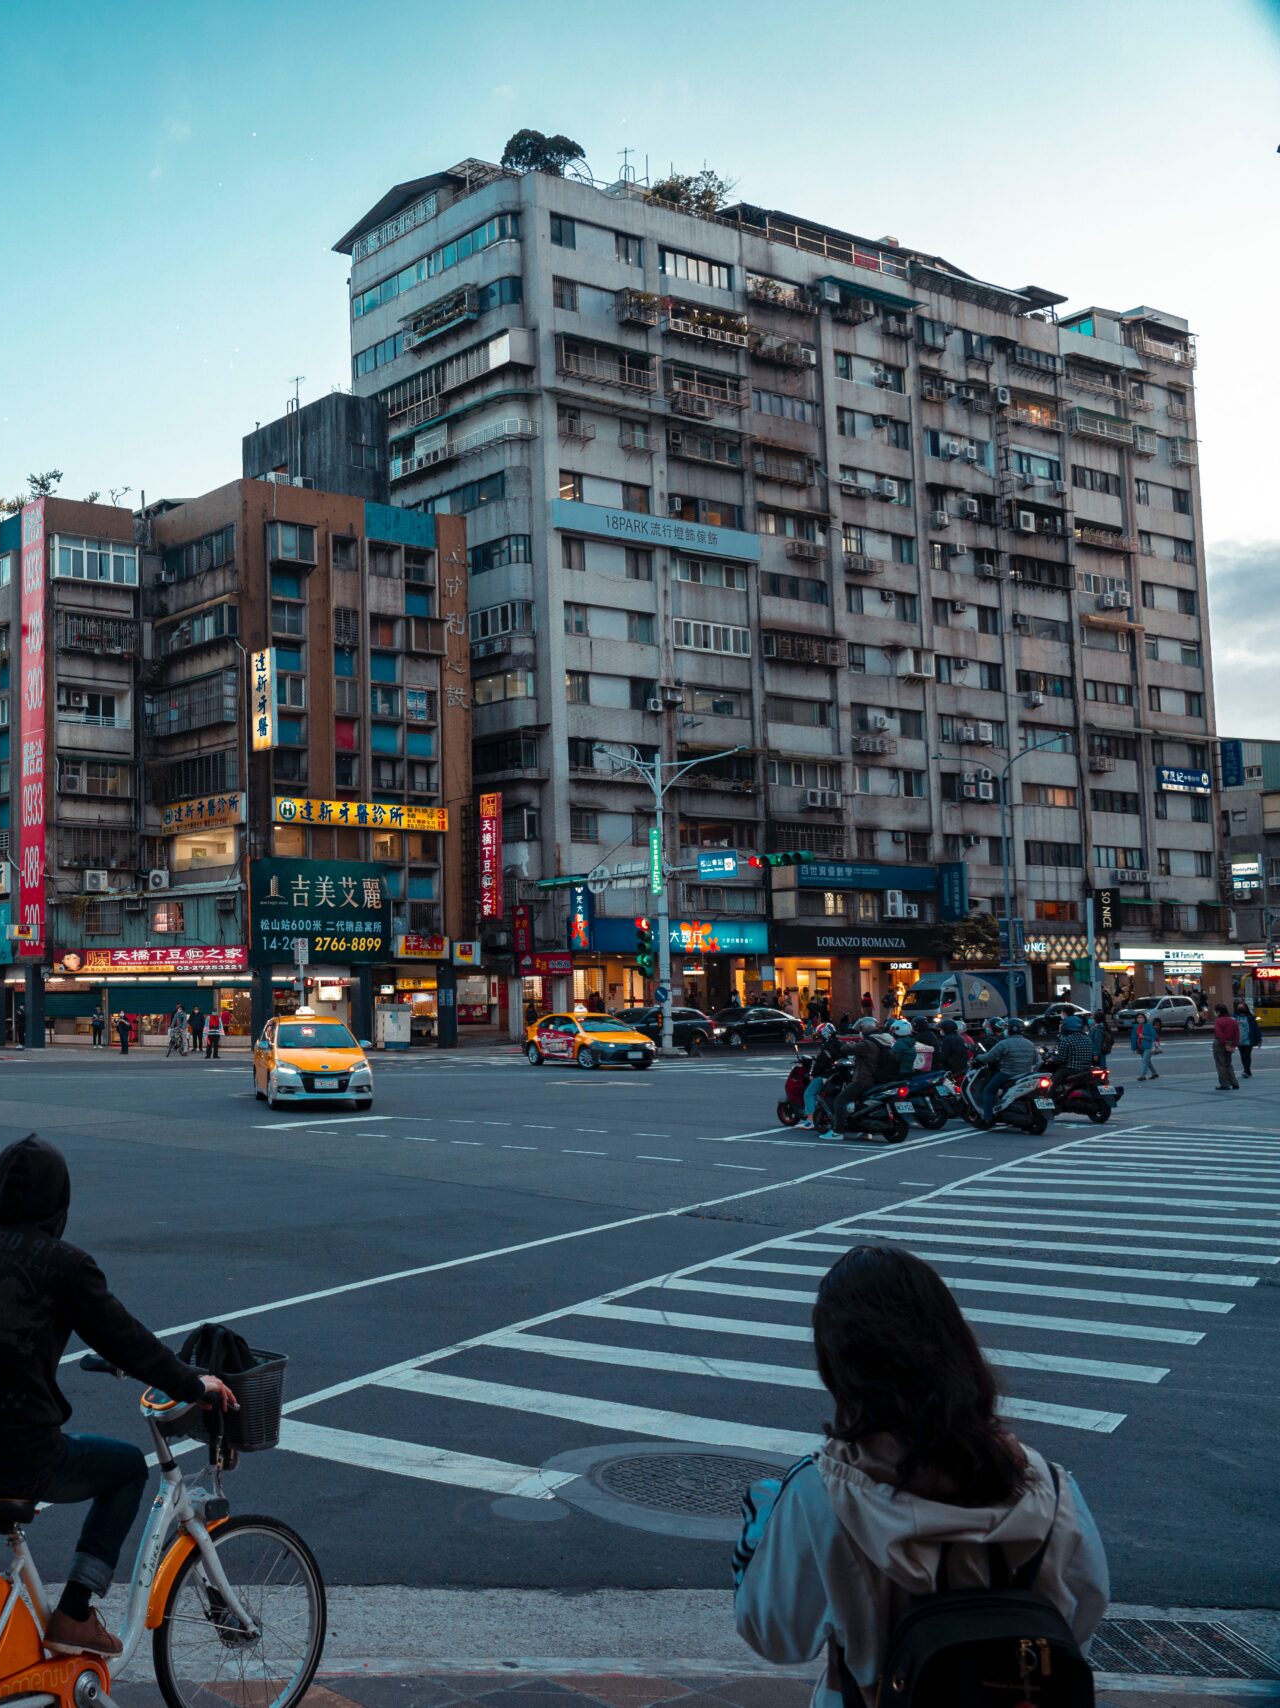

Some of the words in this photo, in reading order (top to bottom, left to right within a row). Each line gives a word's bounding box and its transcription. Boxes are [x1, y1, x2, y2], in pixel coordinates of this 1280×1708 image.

[604, 515, 649, 535] 18PARK
[255, 652, 269, 737] 達新牙醫
[23, 783, 43, 827] 0933
[174, 795, 239, 822] 達新牙醫診所
[299, 801, 405, 827] 達新牙醫診所
[290, 874, 382, 909] 吉美艾麗
[1101, 891, 1111, 904] SO
[260, 919, 322, 931] 松山站600米
[1101, 906, 1112, 928] NICE
[314, 936, 382, 952] 2766-8899
[816, 936, 860, 947] LORANZO
[861, 937, 906, 948] ROMANZA
[1030, 942, 1046, 953] NICE
[1180, 952, 1205, 960] FamilyMart
[890, 962, 898, 970] SO
[898, 962, 913, 970] NICE
